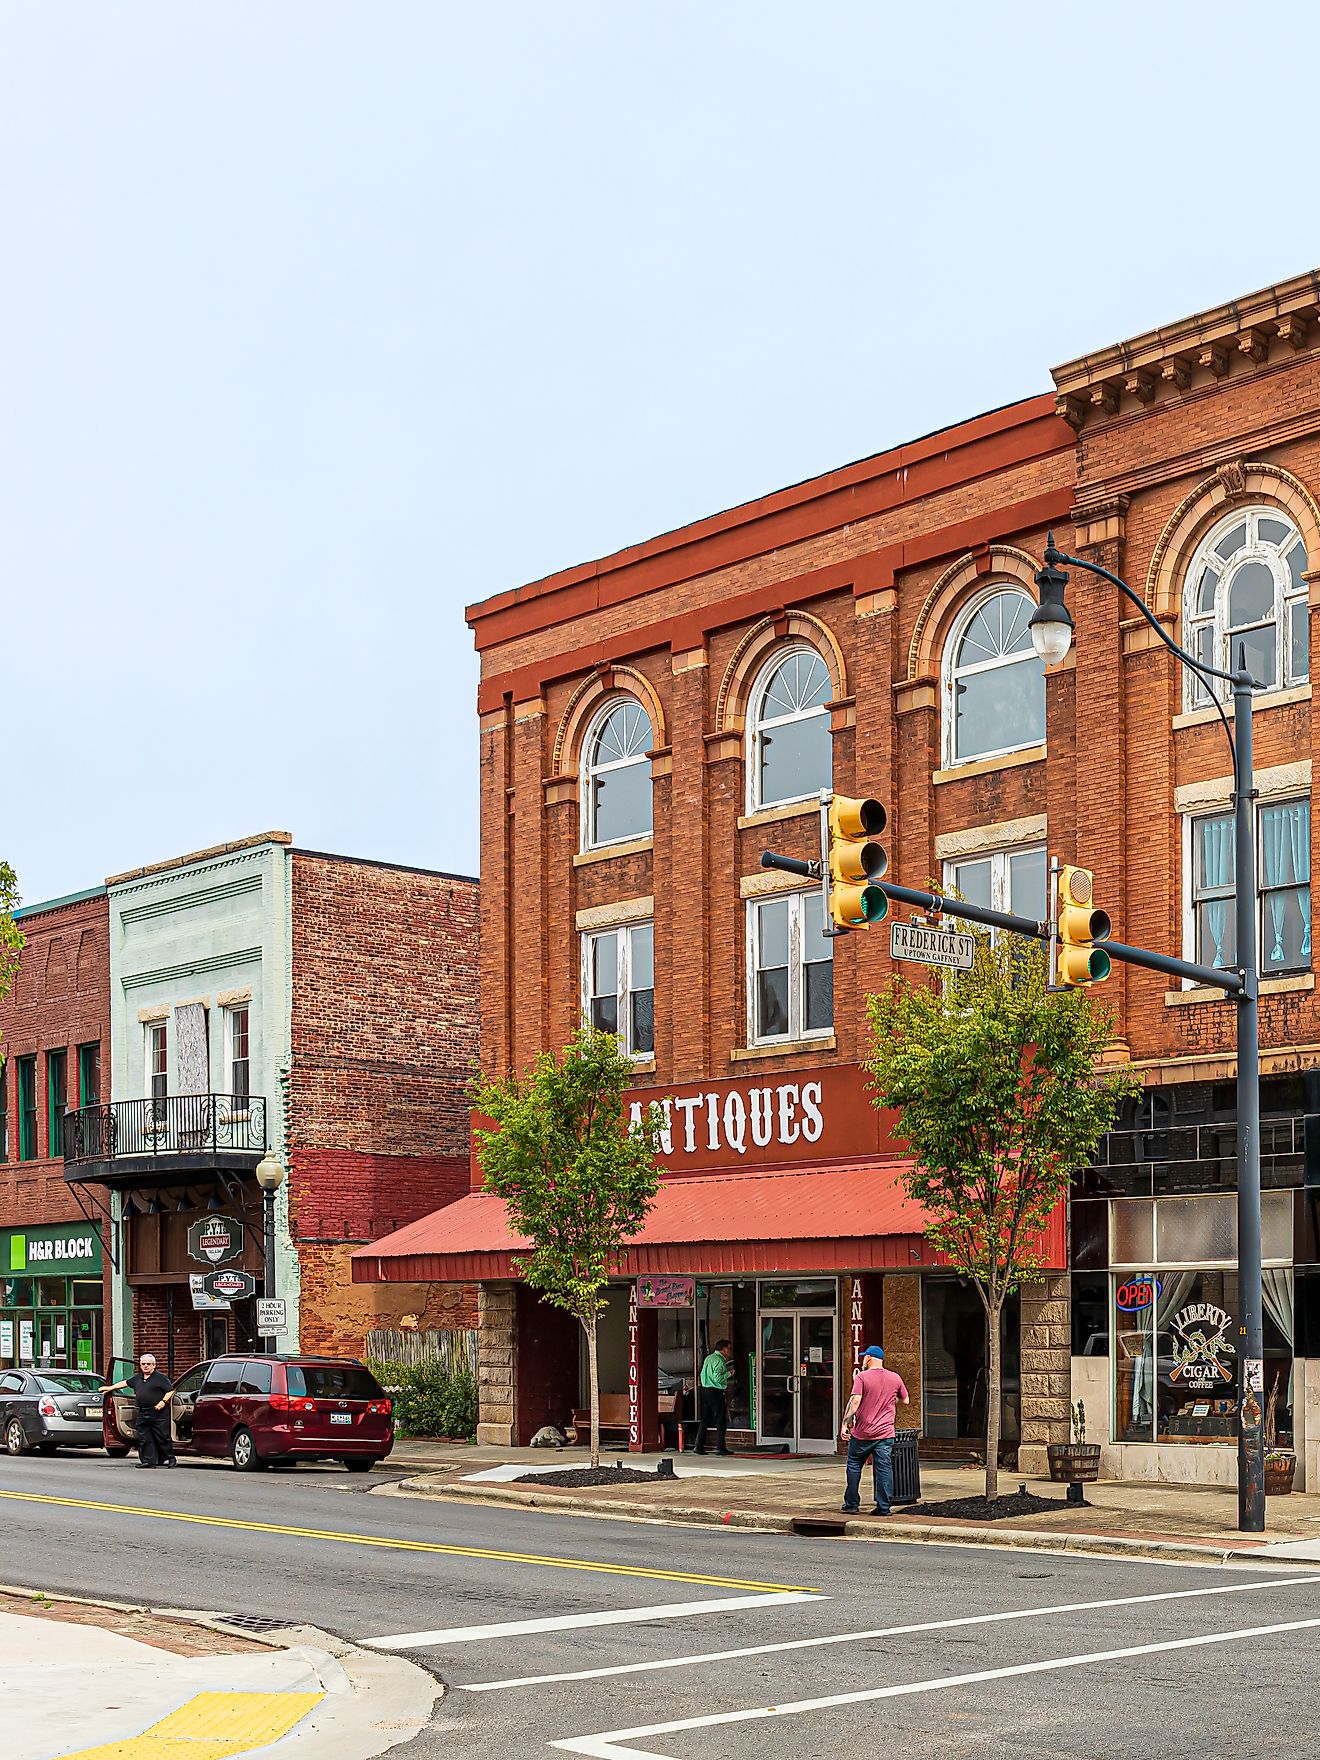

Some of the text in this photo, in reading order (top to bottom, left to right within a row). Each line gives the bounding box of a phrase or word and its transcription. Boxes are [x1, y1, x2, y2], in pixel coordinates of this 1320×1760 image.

[895, 927, 971, 956] FREDERICK ST
[904, 949, 960, 964] UPTOWN GAFFNEY
[29, 1237, 93, 1260] H&R BLOCK
[202, 1237, 229, 1246] LEGENDARY
[1117, 1285, 1153, 1306] OPEN
[1175, 1303, 1232, 1329] LIBERTY
[1239, 1327, 1247, 1335] 21
[629, 1285, 638, 1442] ANTIQUES
[1183, 1366, 1220, 1378] CIGAR
[1189, 1380, 1213, 1389] COFFEE
